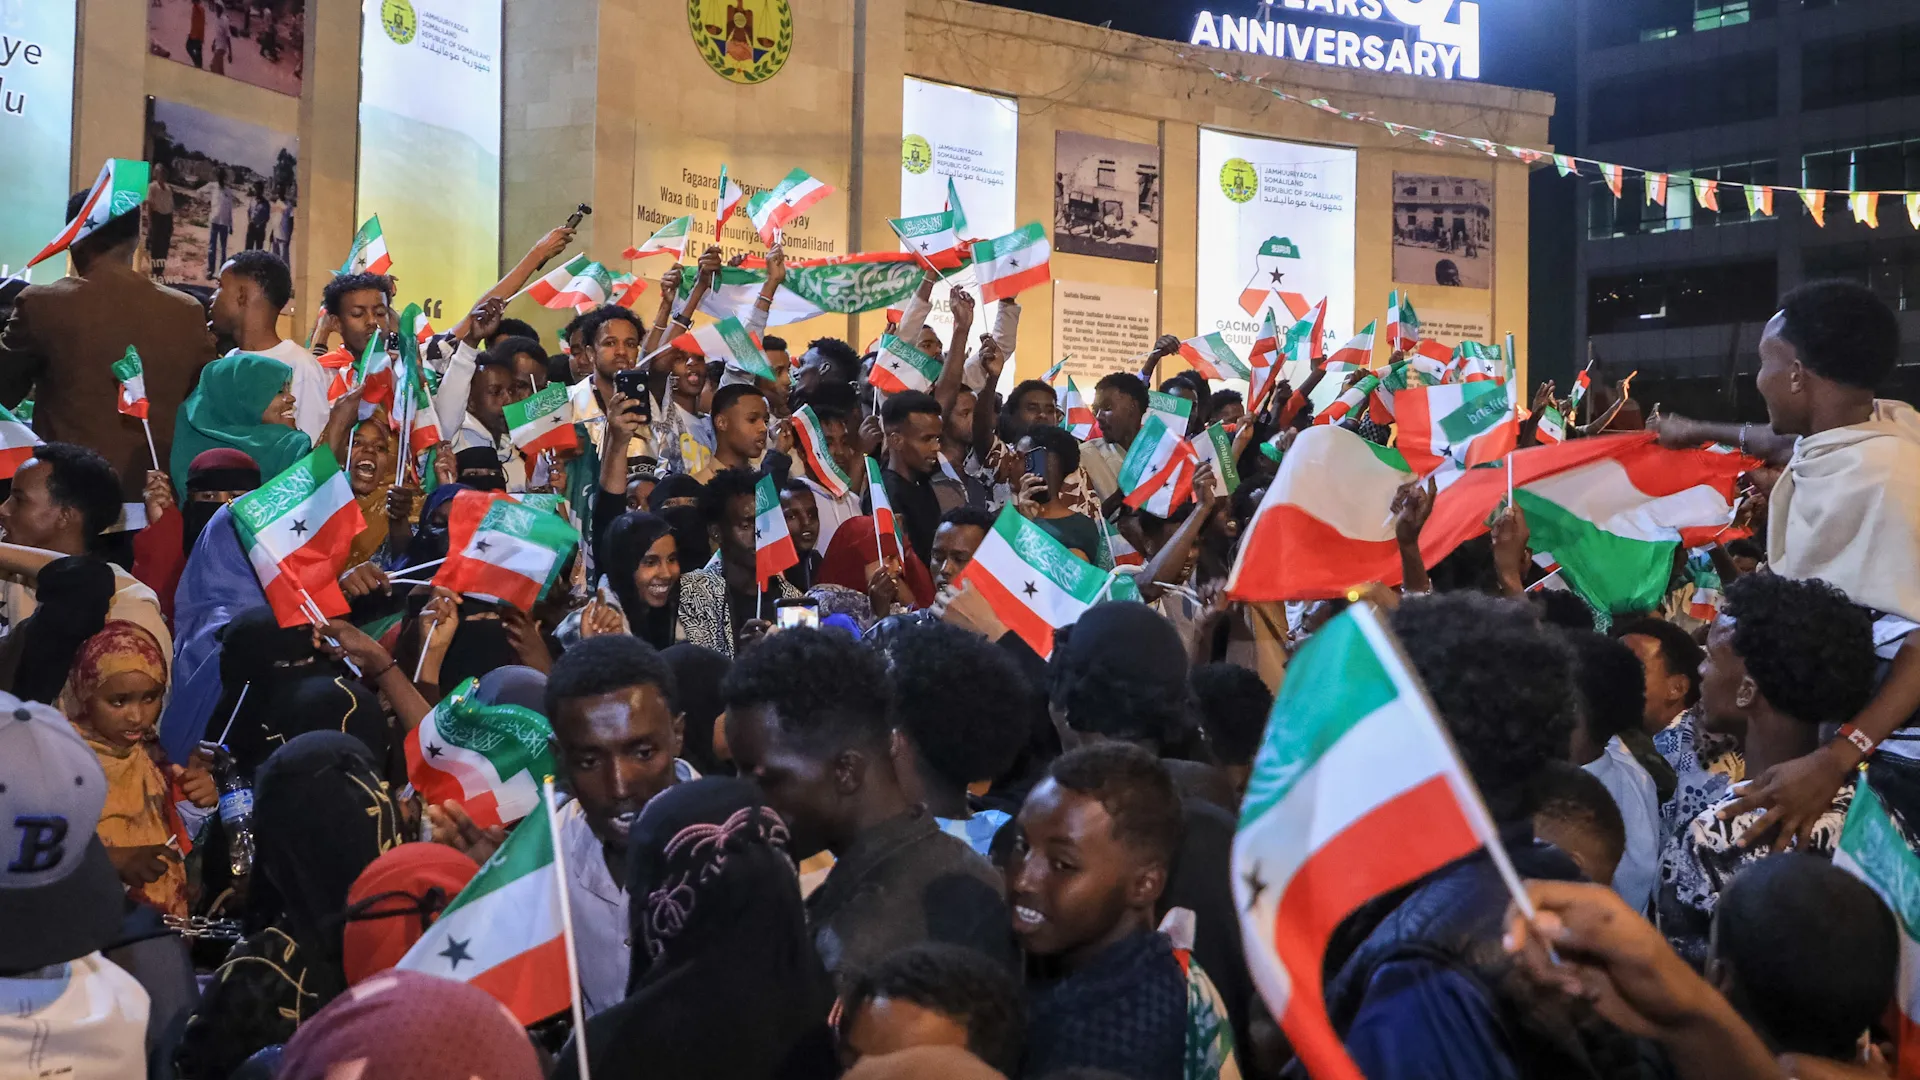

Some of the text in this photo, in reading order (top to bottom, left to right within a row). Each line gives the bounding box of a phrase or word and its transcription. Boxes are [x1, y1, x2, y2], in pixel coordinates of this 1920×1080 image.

[1190, 10, 1460, 79] ANNIVERSARY
[1264, 176, 1304, 187] SOMALILAND
[1264, 185, 1293, 195] REPUBLIC
[1304, 191, 1343, 201] SOMALILAND
[660, 186, 683, 205] Waxa
[686, 192, 699, 209] dib
[702, 199, 708, 211] u
[781, 232, 834, 254] Somaliland
[1216, 320, 1260, 333] GACMO
[1215, 434, 1236, 479] Somaliland
[7, 814, 69, 873] B
